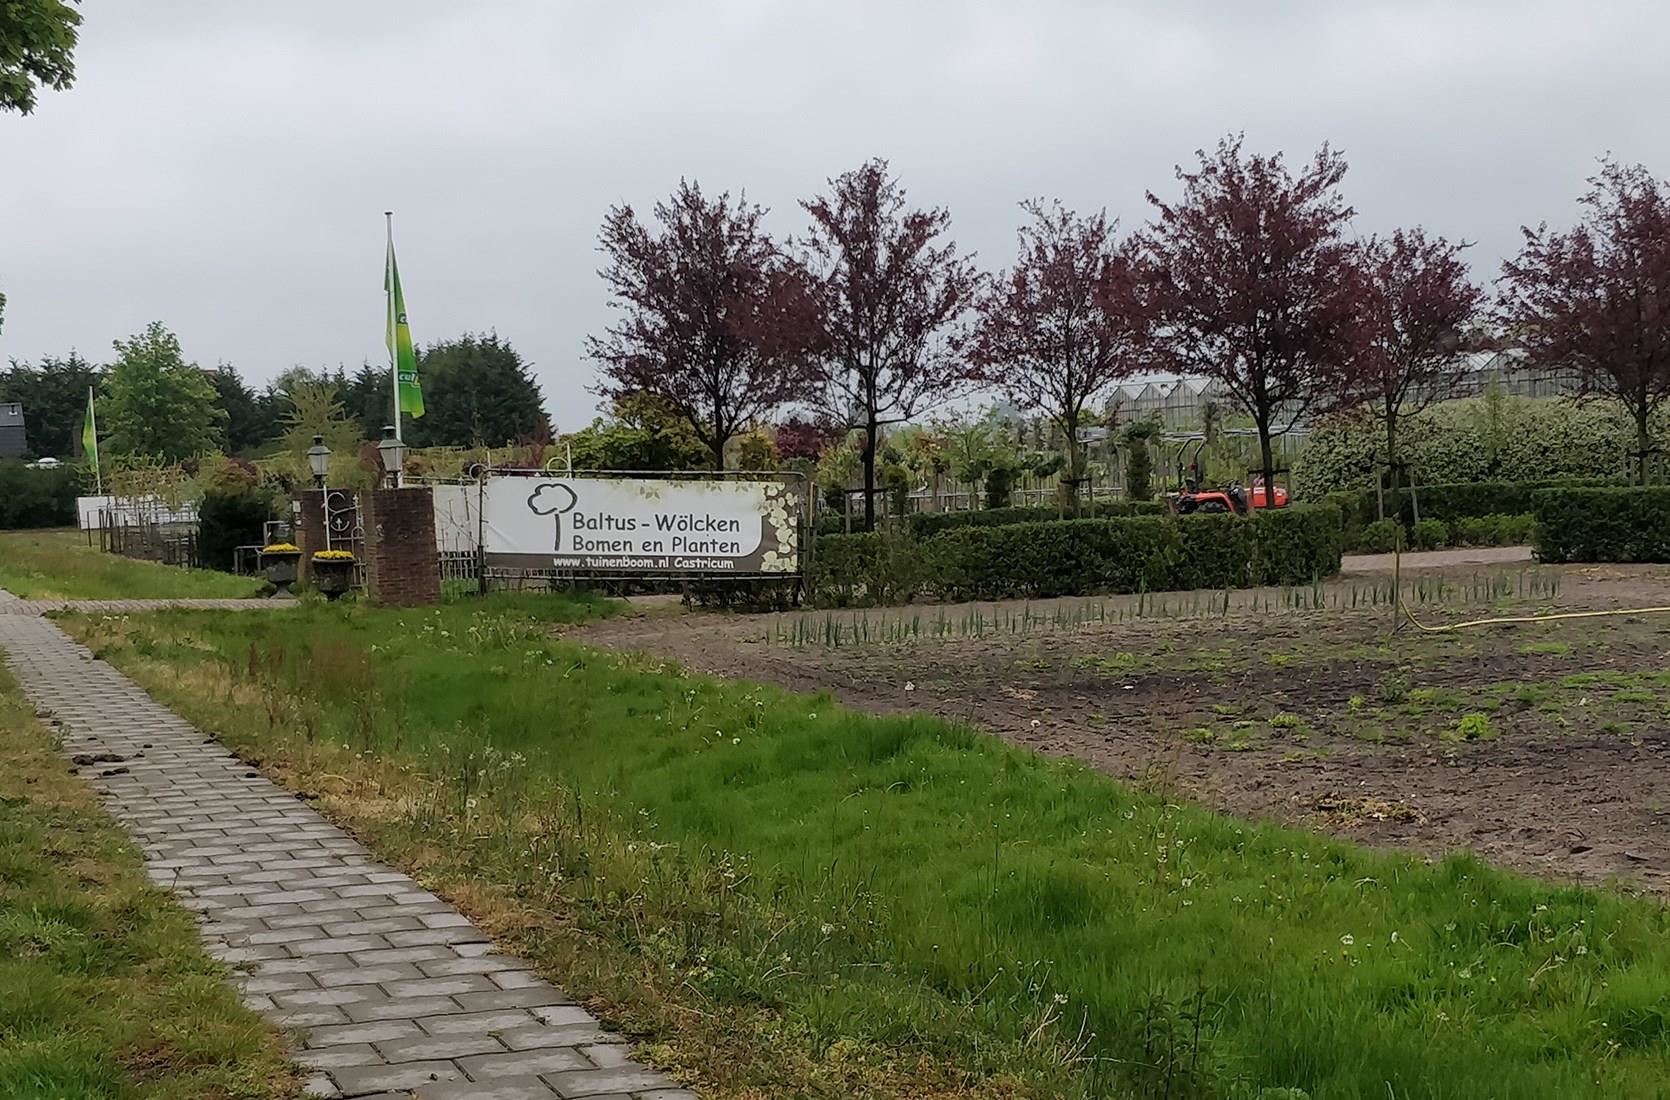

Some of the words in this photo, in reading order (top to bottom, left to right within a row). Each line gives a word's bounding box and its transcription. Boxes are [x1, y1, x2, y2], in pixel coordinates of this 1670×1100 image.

[573, 535, 633, 552] Bomen
[642, 540, 663, 552] en
[672, 536, 740, 553] Planten
[553, 556, 669, 568] www.tuinenboom.nl
[674, 557, 735, 569] Castricum
